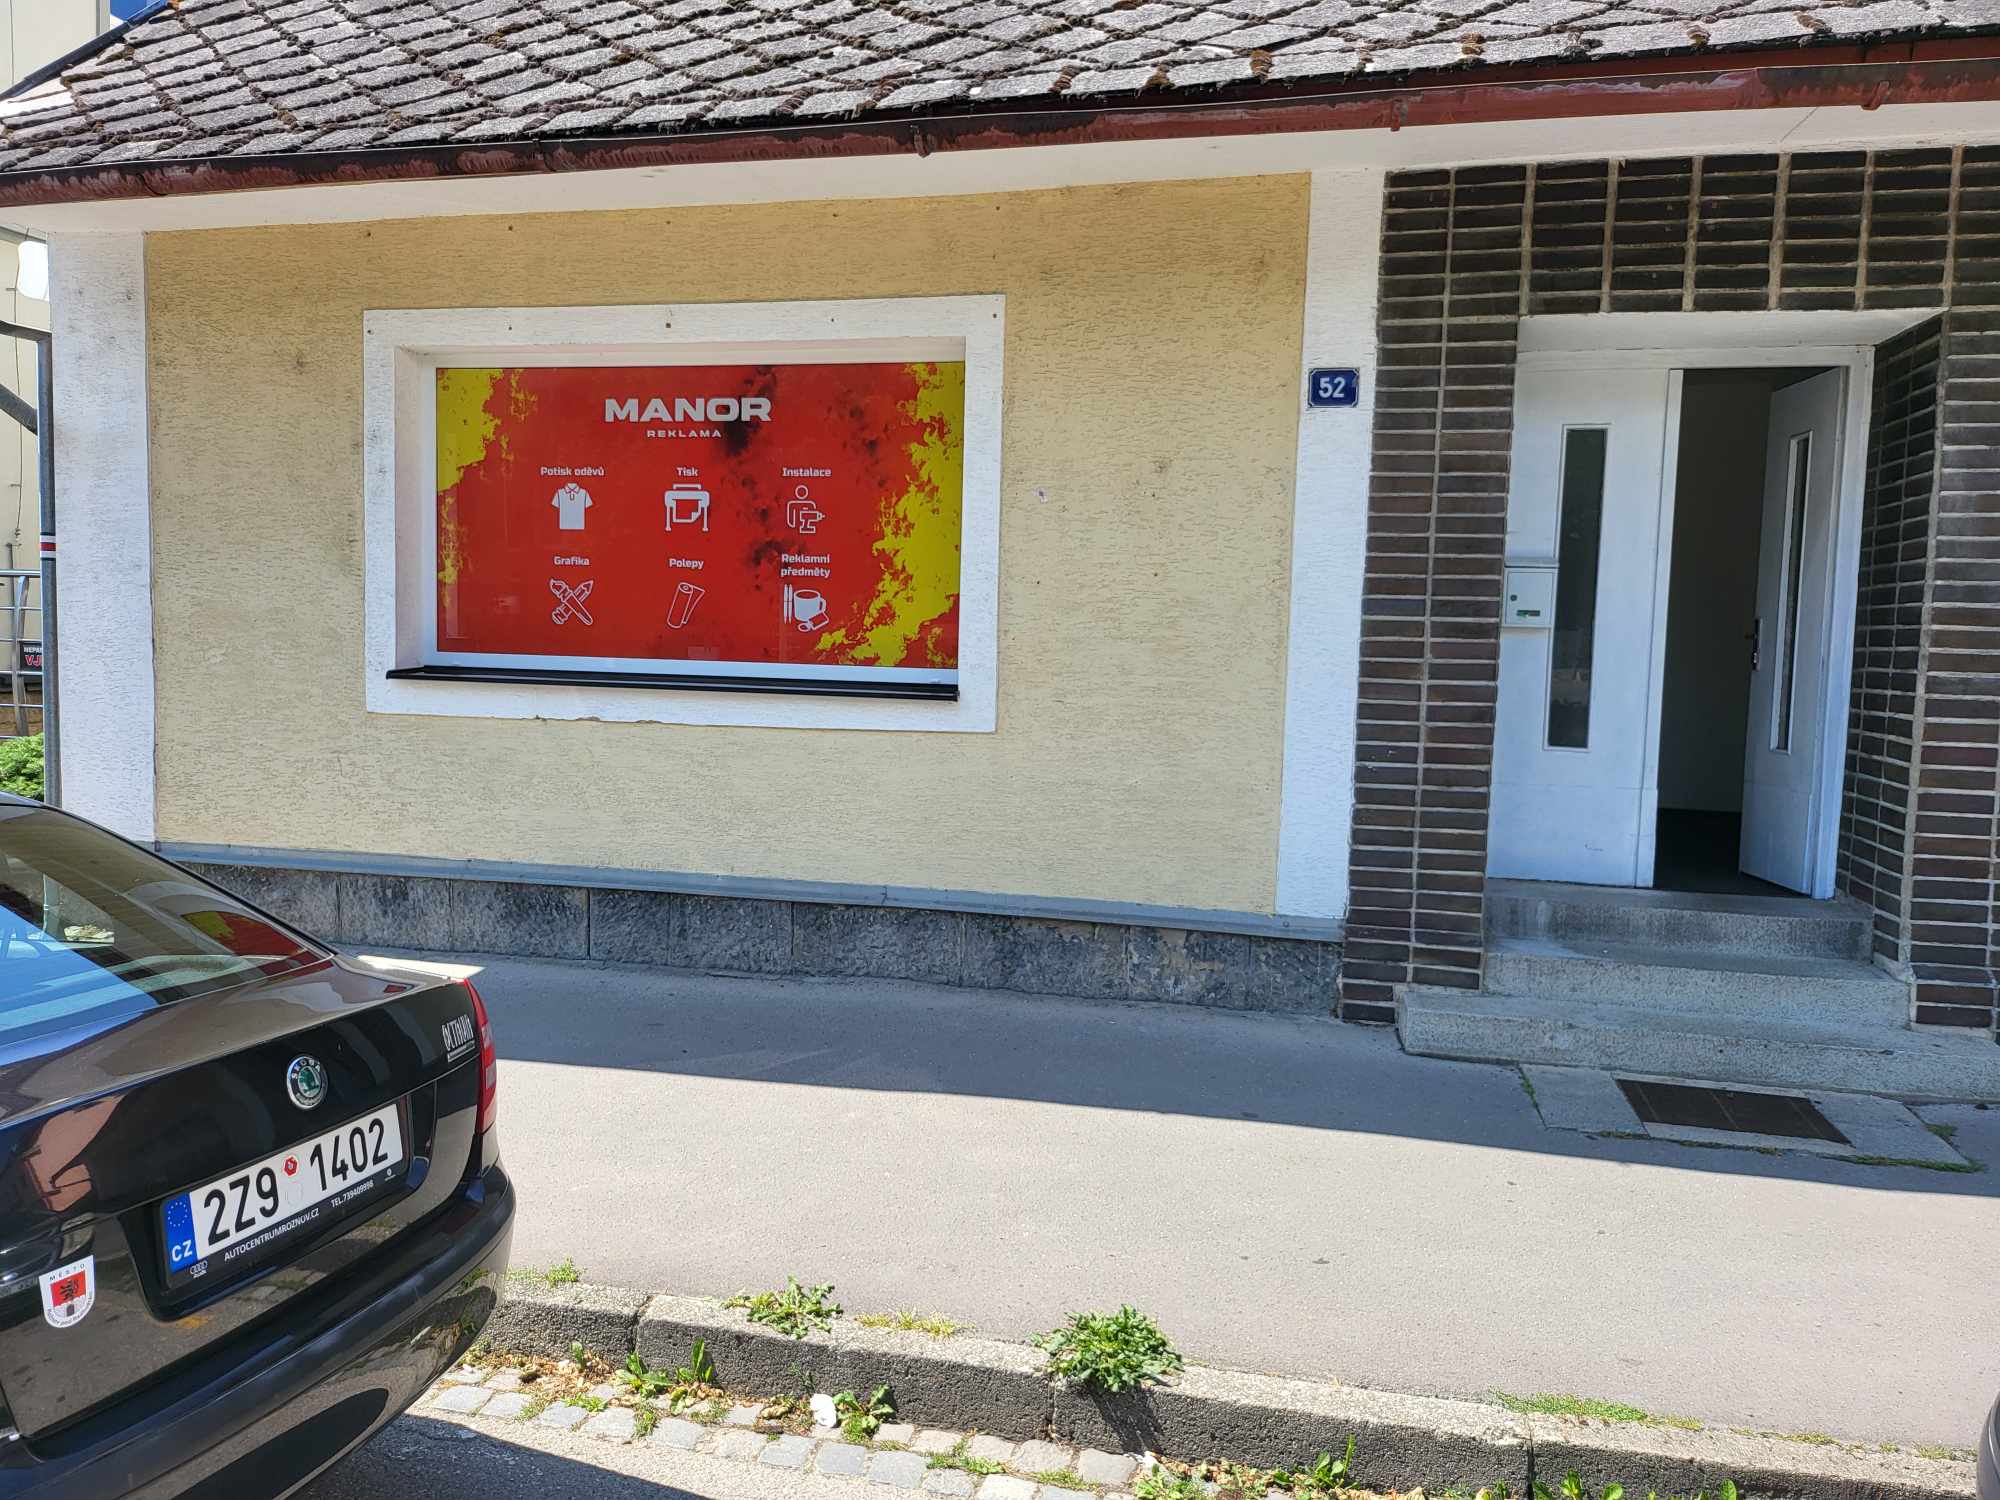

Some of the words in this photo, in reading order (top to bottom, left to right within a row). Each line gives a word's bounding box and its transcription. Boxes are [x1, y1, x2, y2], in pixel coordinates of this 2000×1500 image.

[1318, 376, 1346, 399] 52
[604, 397, 772, 423] MANOR
[646, 429, 722, 439] REKLAMA
[540, 466, 572, 477] Potisk
[574, 466, 605, 477] oděvů
[676, 466, 699, 478] Tisk
[782, 467, 832, 478] Instalace
[553, 555, 591, 567] Grafika
[668, 557, 705, 571] Polepy
[781, 553, 831, 564] Reklamní
[780, 566, 831, 579] předměty
[203, 1166, 280, 1248] 2Z9
[310, 1117, 389, 1193] 1402
[171, 1239, 193, 1263] CZ
